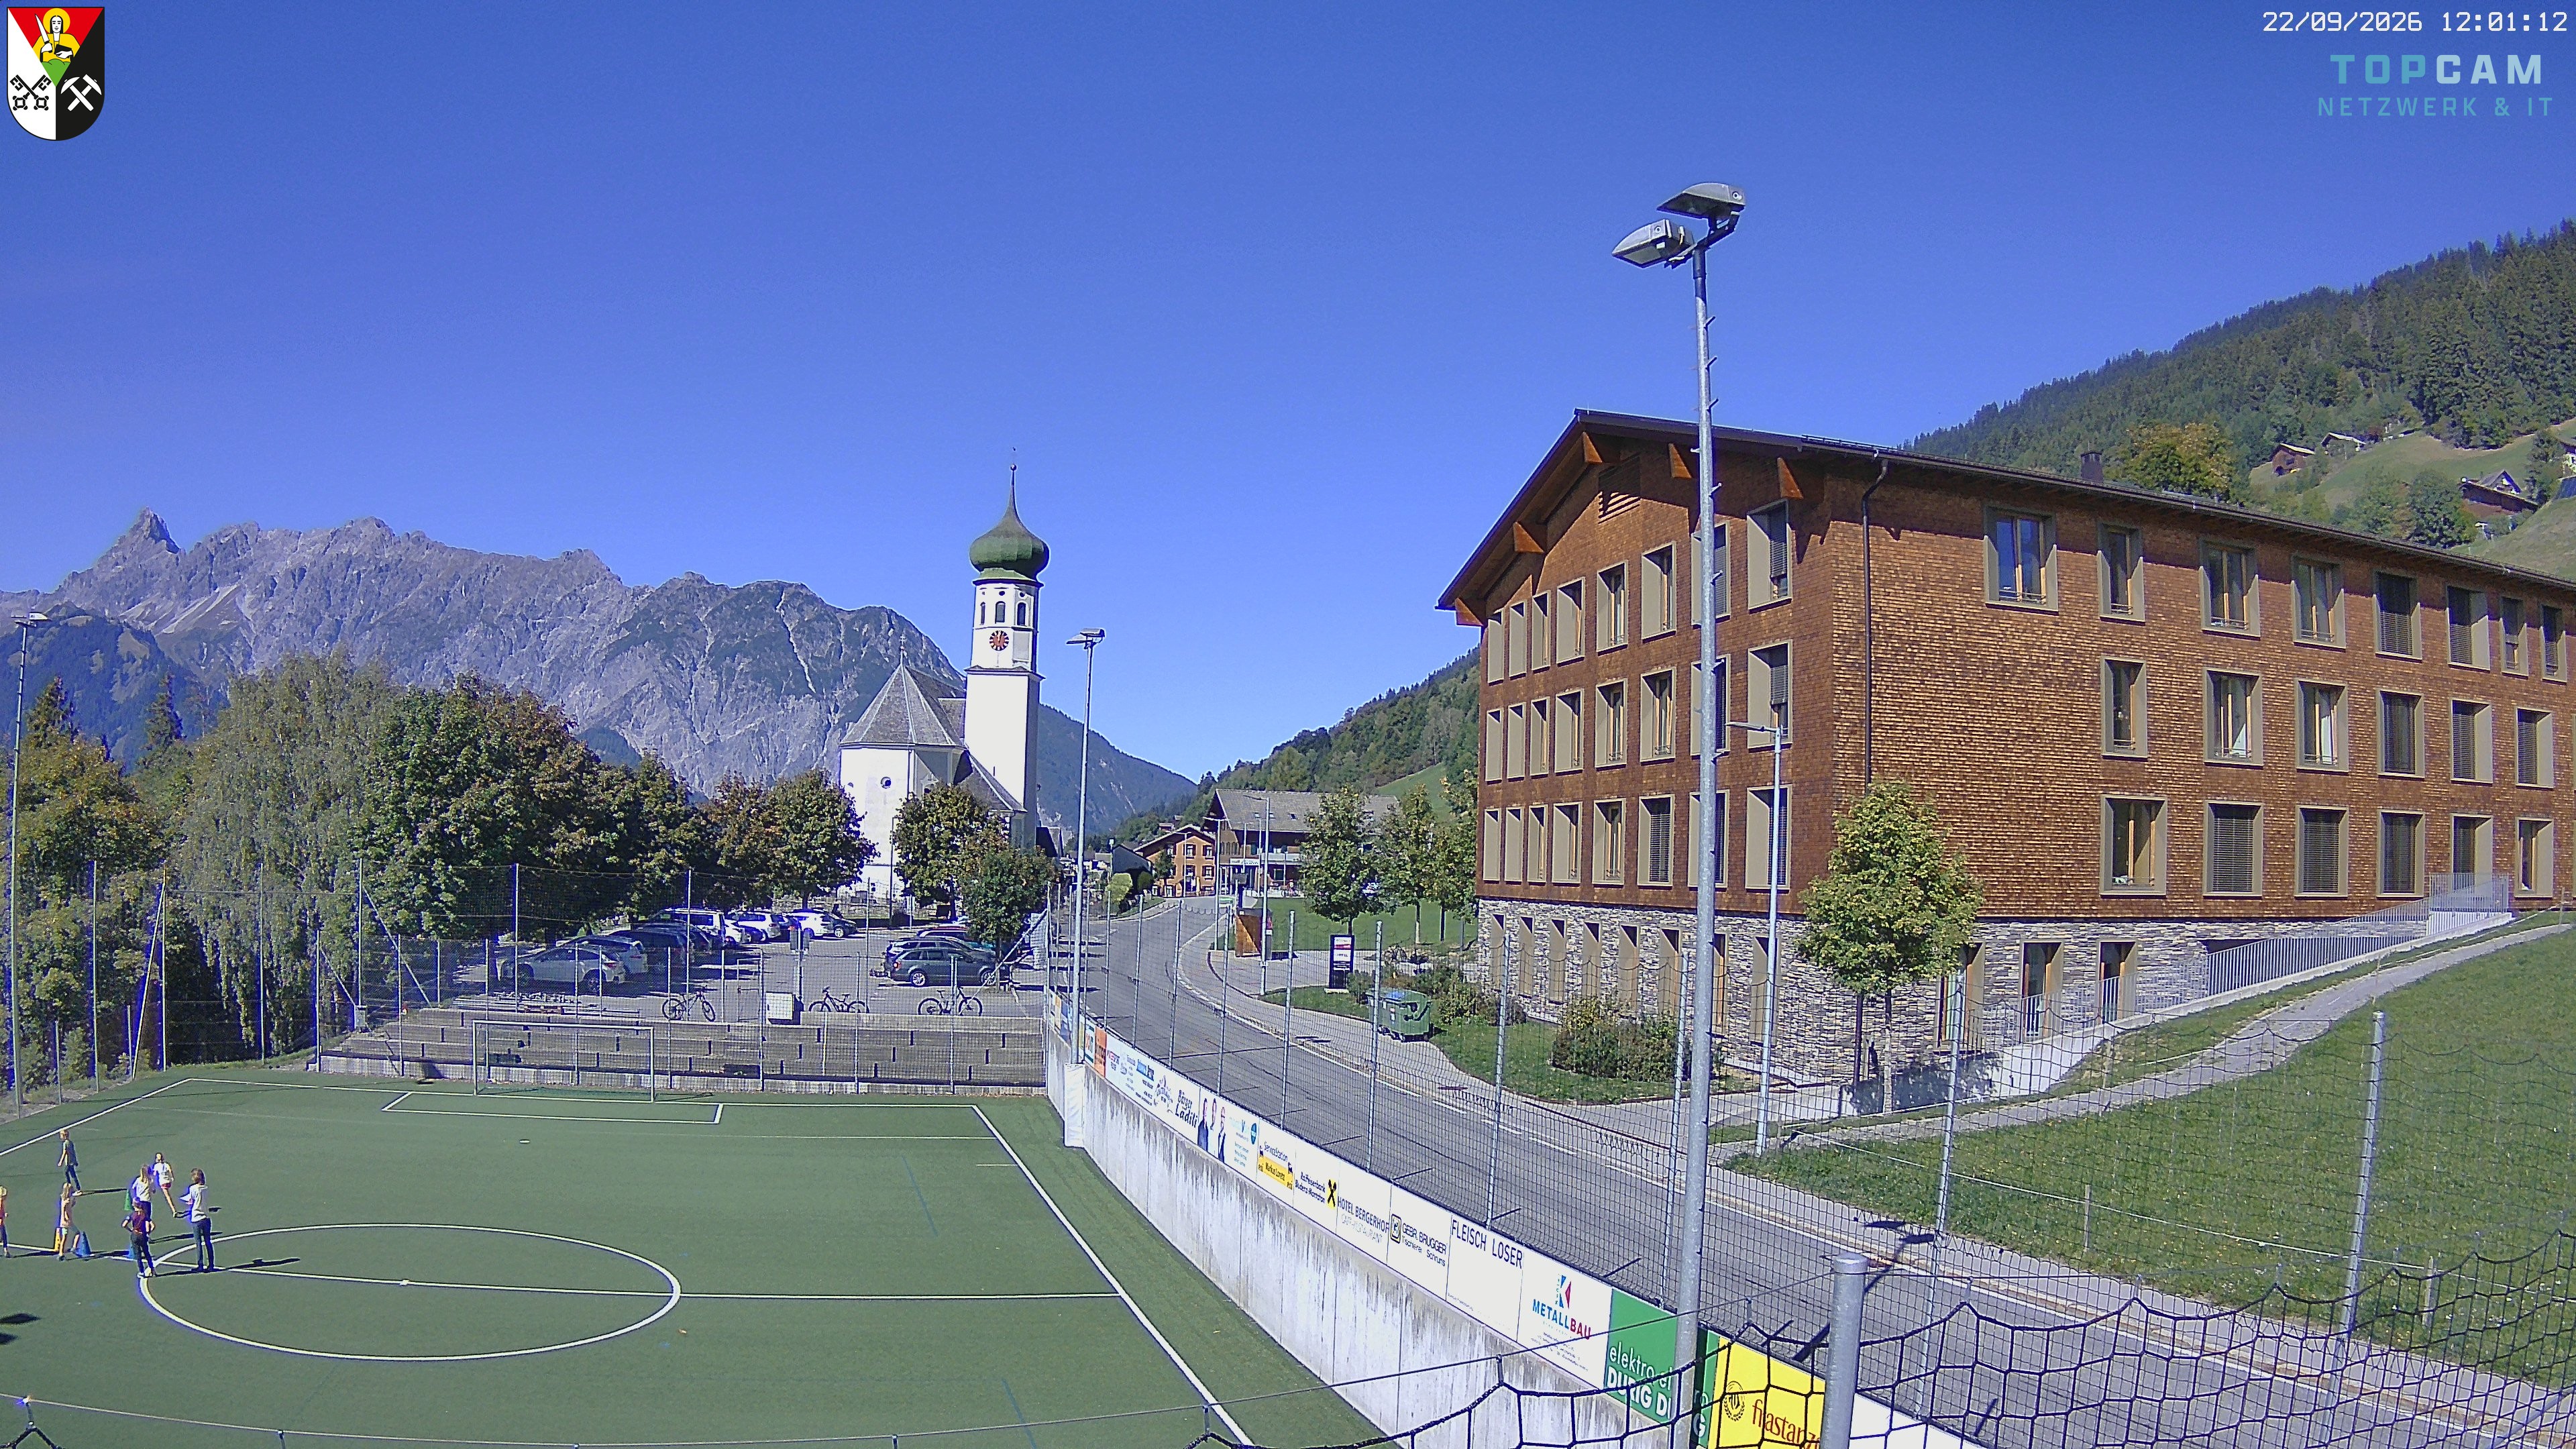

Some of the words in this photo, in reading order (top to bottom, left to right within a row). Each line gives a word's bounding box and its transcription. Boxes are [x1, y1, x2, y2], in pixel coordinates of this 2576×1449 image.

[1337, 1195, 1354, 1216] HOTEL
[1355, 1206, 1389, 1234] BERGERHOF
[1452, 1219, 1487, 1252] FLEISCH
[1492, 1238, 1523, 1269] LOSER
[1532, 1298, 1591, 1340] METALLBAU
[1609, 1341, 1655, 1381] elektro
